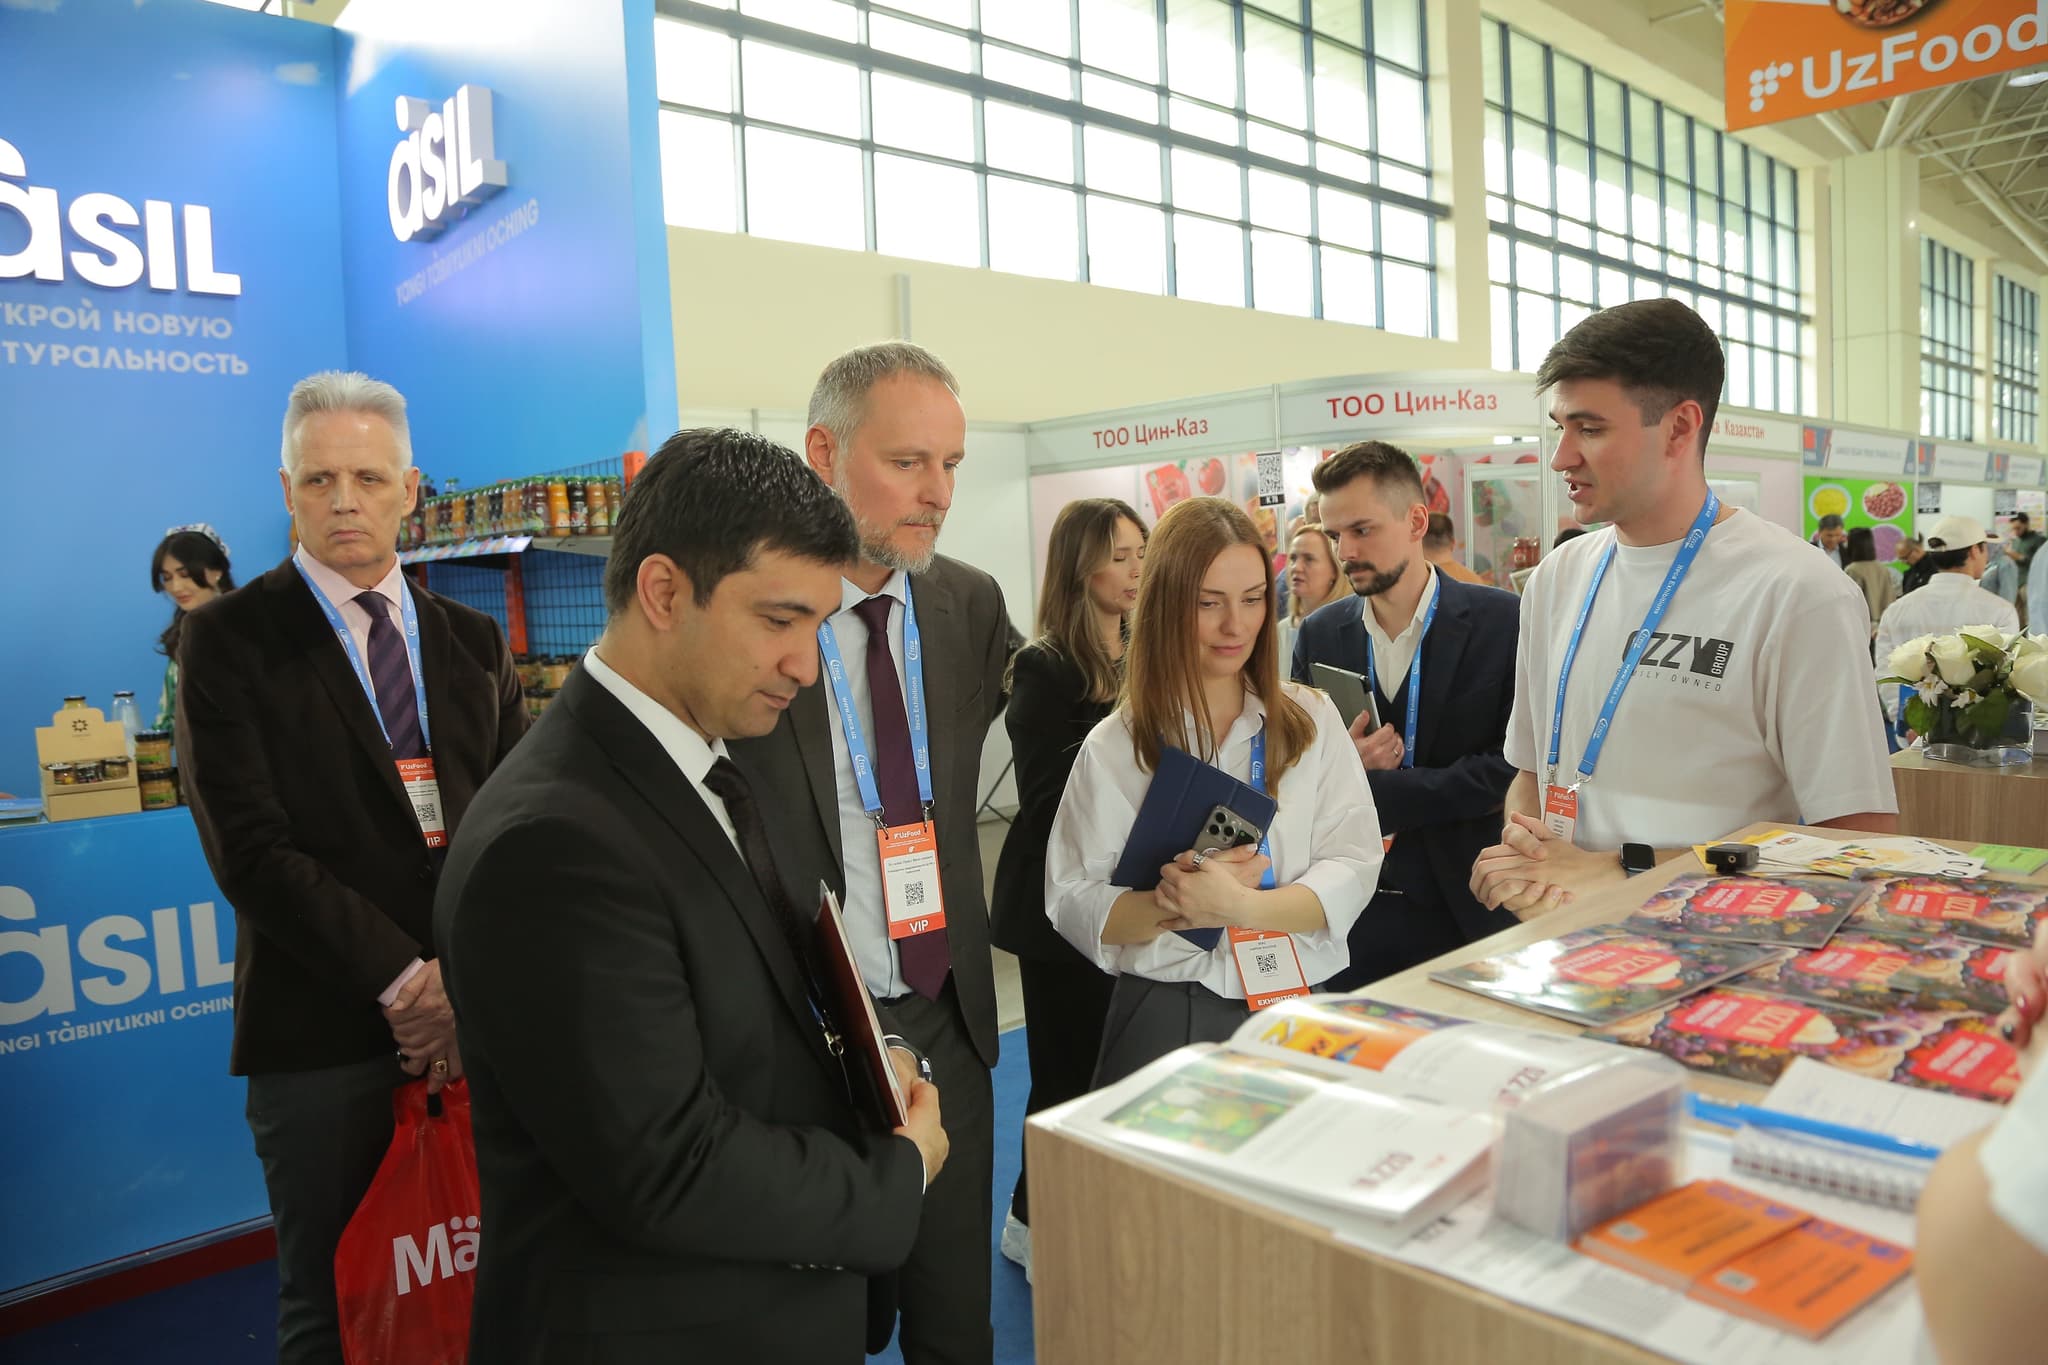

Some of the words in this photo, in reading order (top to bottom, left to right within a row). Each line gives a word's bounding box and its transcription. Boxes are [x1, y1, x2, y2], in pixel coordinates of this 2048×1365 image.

[1802, 0, 2048, 99] UzFood
[0, 298, 101, 332] КРОЙ
[113, 310, 233, 339] НОВУЮ
[1327, 393, 1385, 419] ТОО
[1394, 389, 1498, 416] Цин-Каз
[1092, 427, 1130, 449] ТОО
[1135, 417, 1208, 446] Цин-Каз
[1711, 643, 1729, 675] GROUP
[1671, 674, 1722, 692] OWNED
[909, 919, 929, 934] VIP
[1257, 994, 1299, 1006] EXHIBITOR
